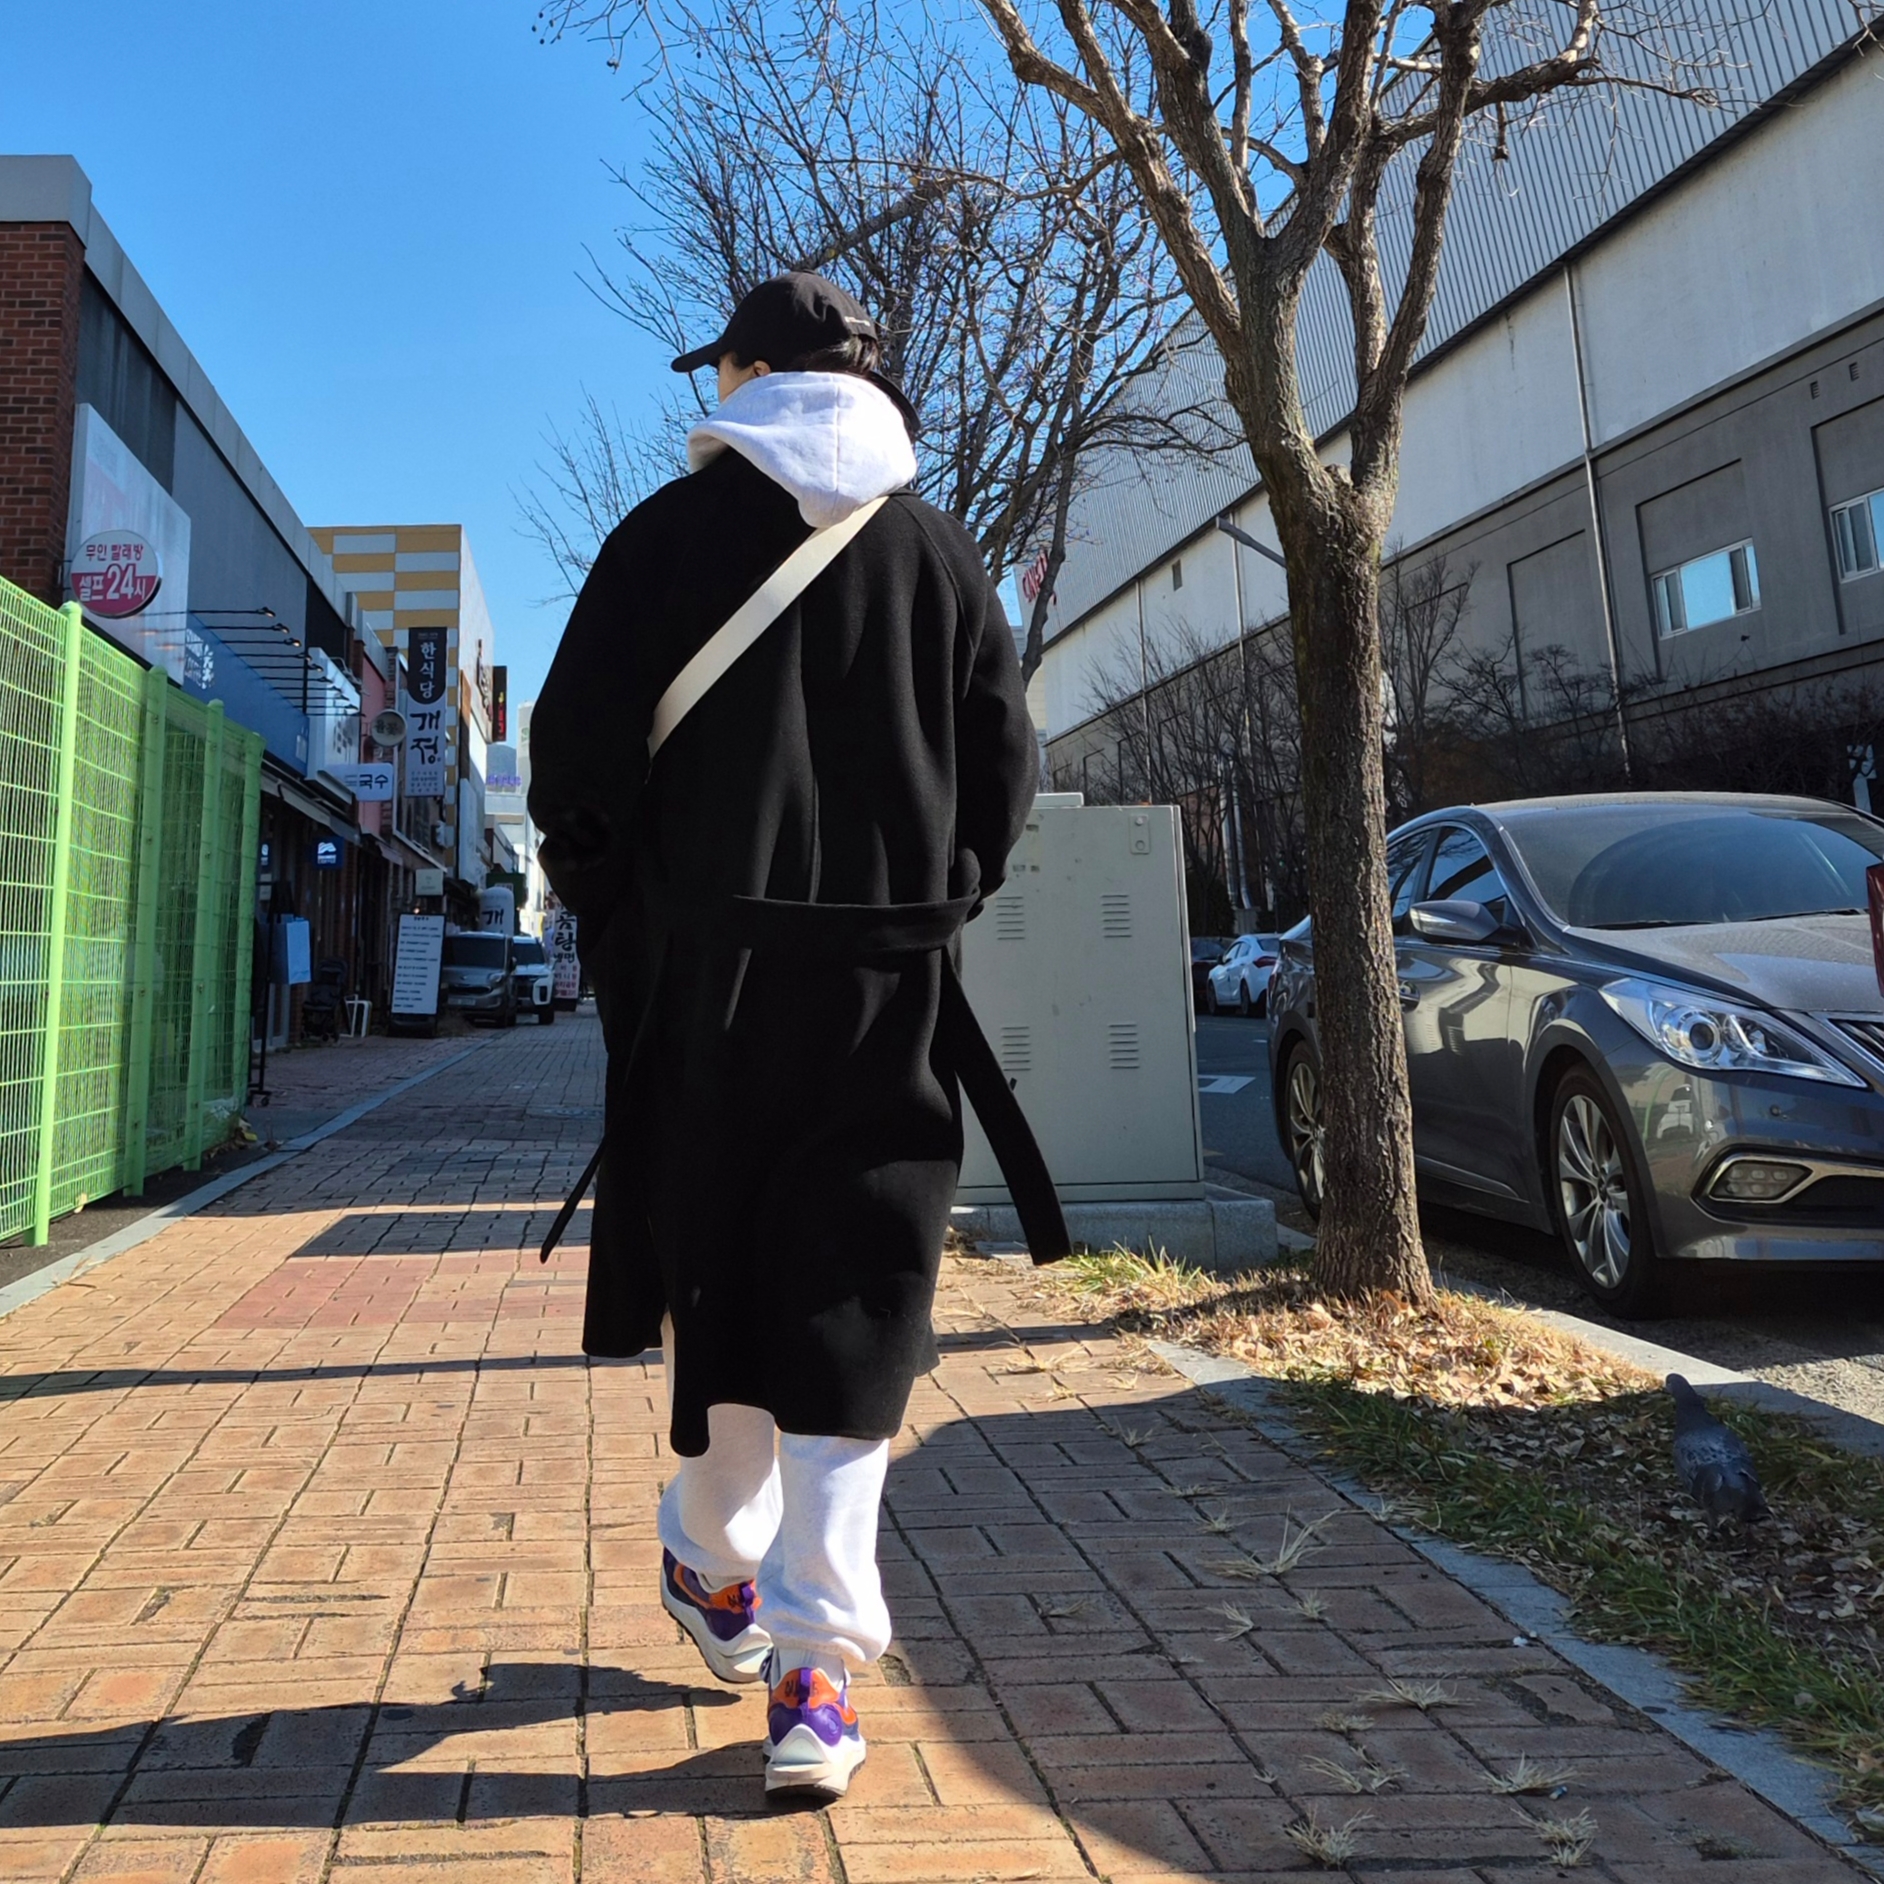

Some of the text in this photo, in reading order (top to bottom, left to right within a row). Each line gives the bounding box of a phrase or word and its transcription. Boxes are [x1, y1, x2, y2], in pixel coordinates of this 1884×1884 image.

[85, 543, 144, 562] 무인 빨래방
[79, 564, 146, 602] 셀프 24시
[419, 641, 437, 699] 한식당
[409, 710, 441, 766] 개정
